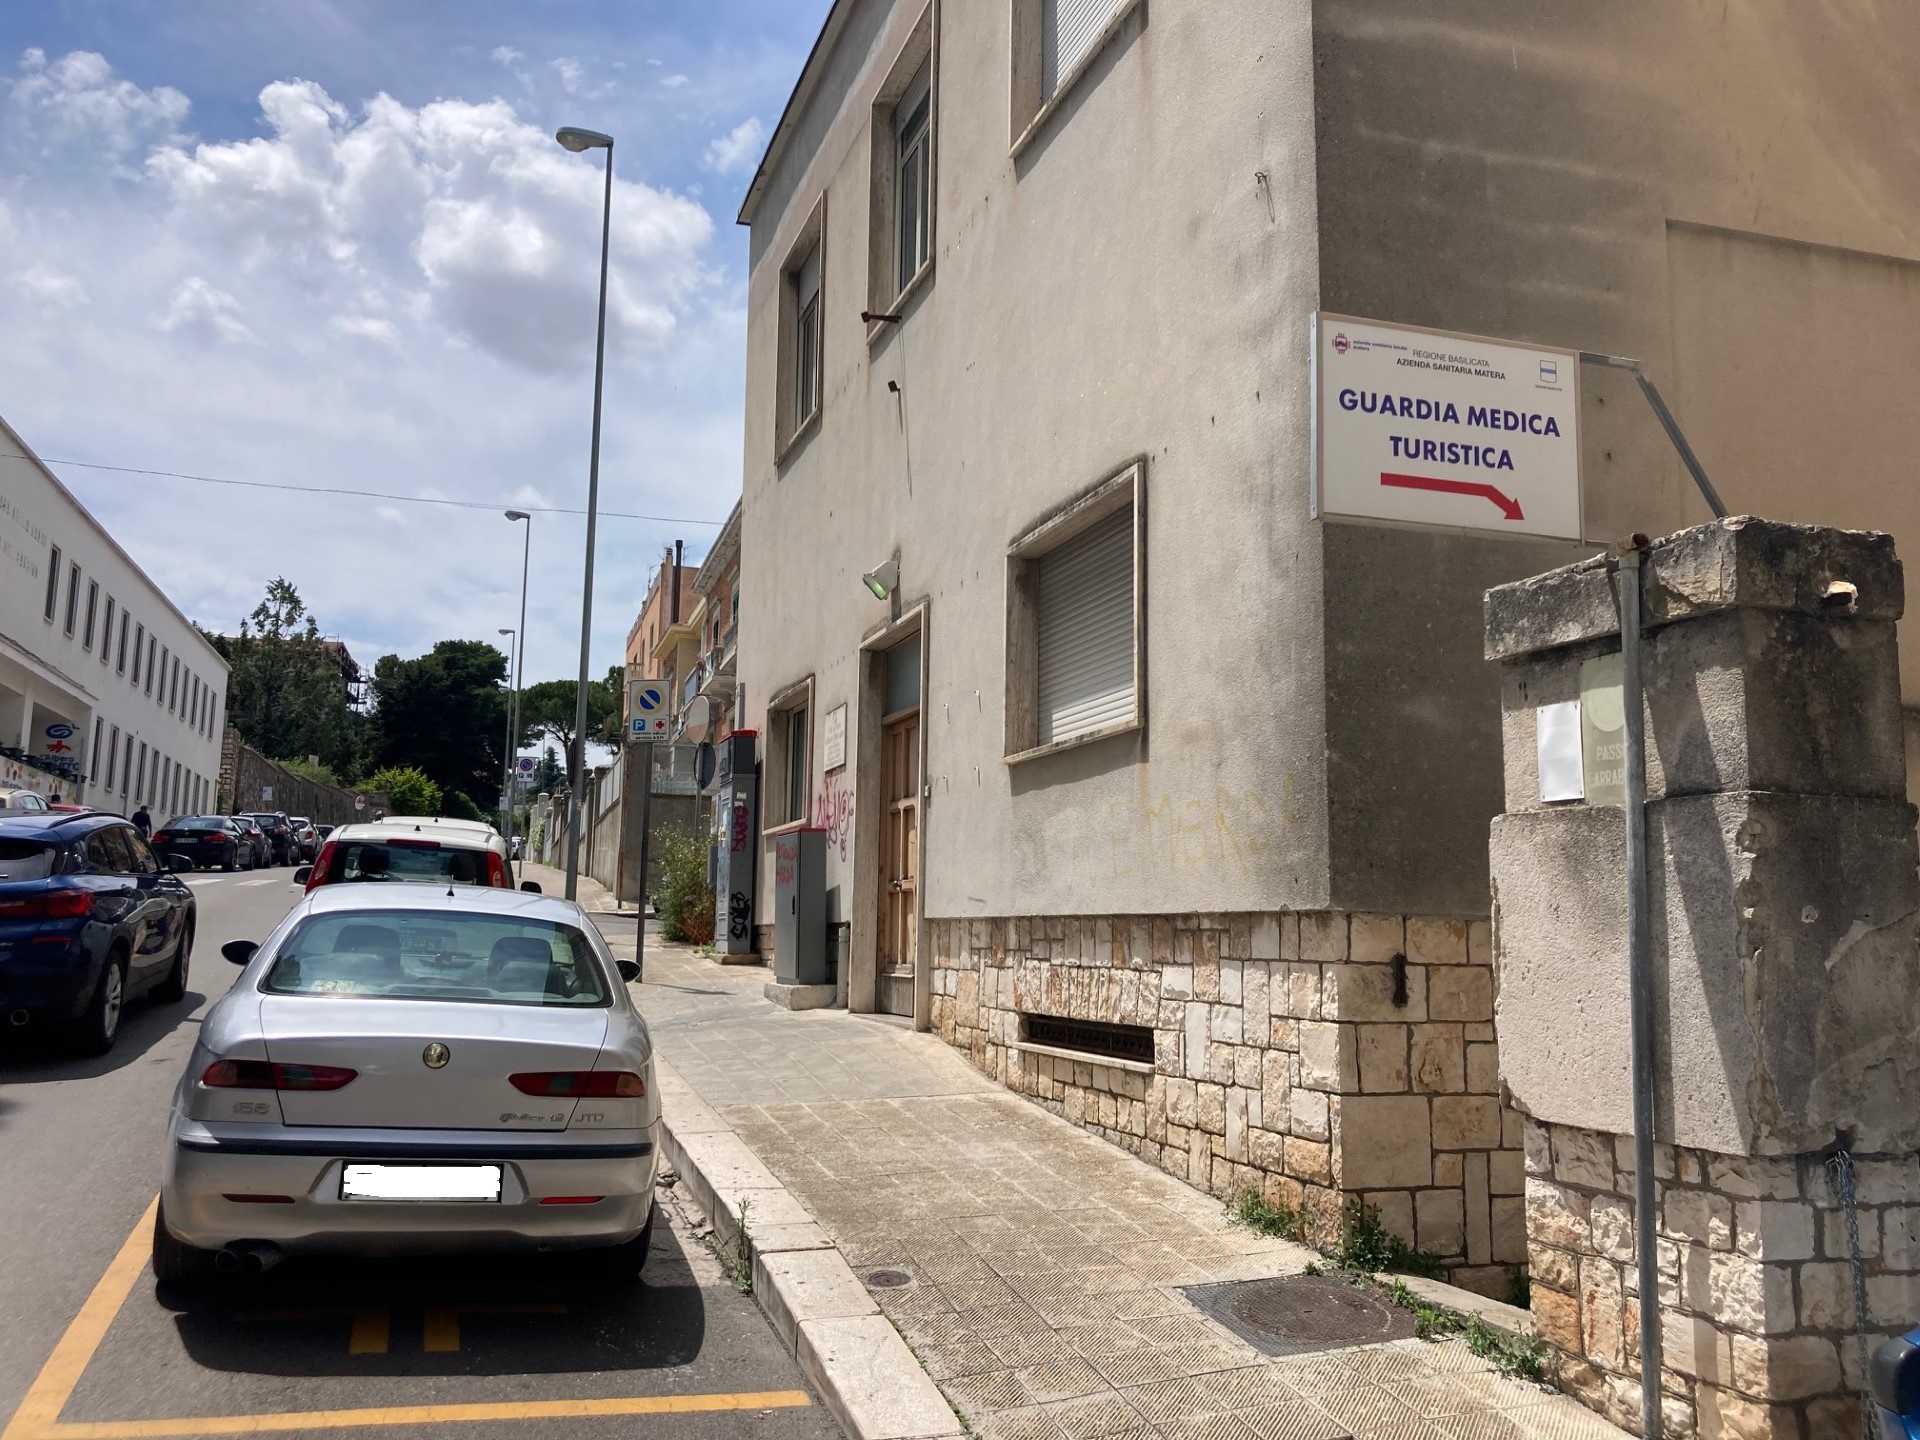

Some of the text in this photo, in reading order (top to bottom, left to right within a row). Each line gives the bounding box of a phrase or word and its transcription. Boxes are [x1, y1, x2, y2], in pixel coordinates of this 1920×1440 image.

[1412, 349, 1490, 367] REGIONE BASILICATA
[1396, 358, 1506, 380] AZIENDA SANITARIA MATERA
[1339, 388, 1561, 437] GUARDIA MEDICA
[1389, 435, 1514, 470] TURISTICA
[635, 720, 644, 730] P
[1596, 743, 1627, 762] PASS
